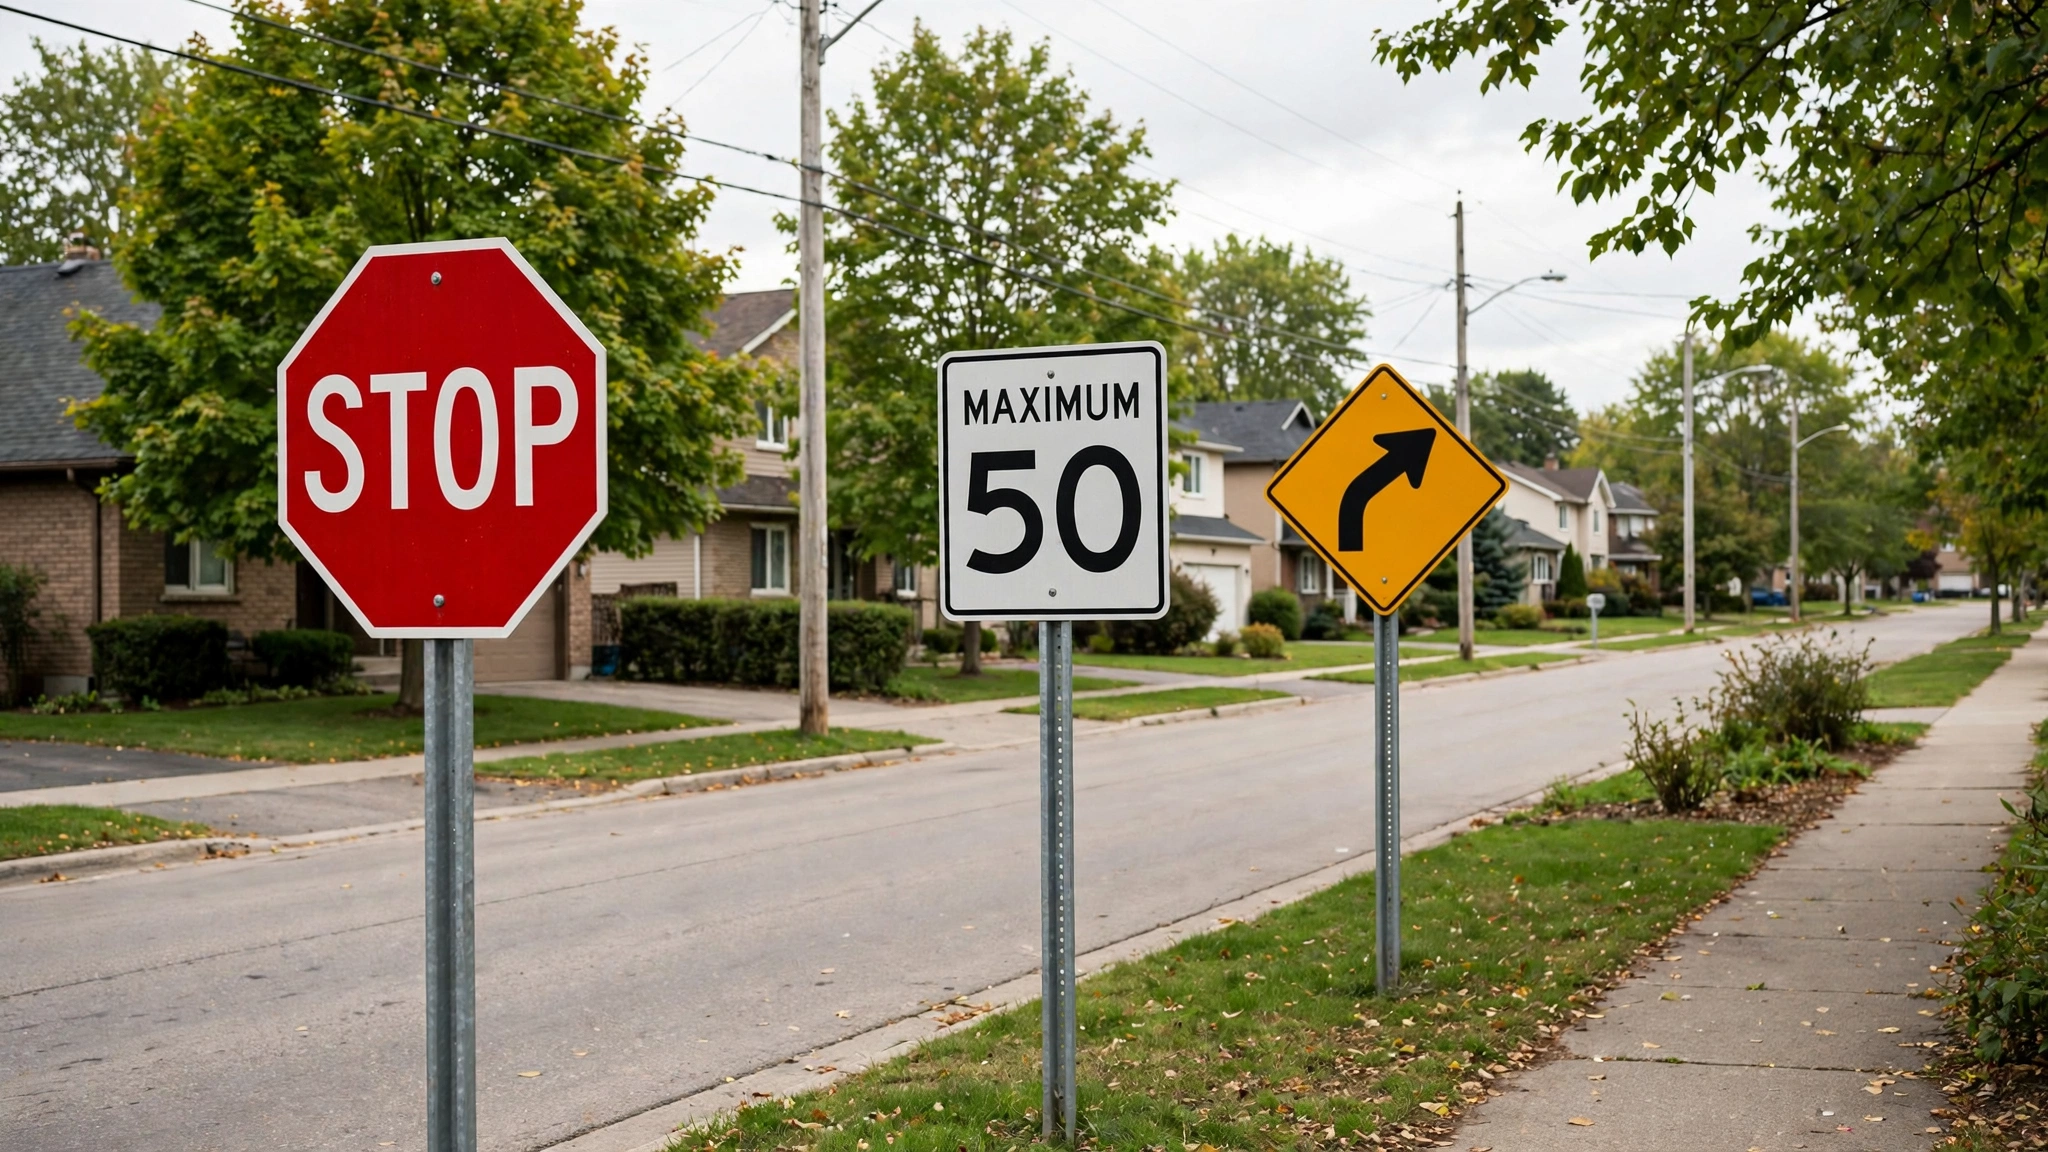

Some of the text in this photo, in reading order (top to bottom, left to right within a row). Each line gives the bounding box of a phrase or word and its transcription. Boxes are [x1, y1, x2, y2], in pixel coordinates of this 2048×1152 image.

[304, 366, 579, 513] STOP
[963, 382, 1140, 426] MAXIMUM
[966, 445, 1142, 575] 50
